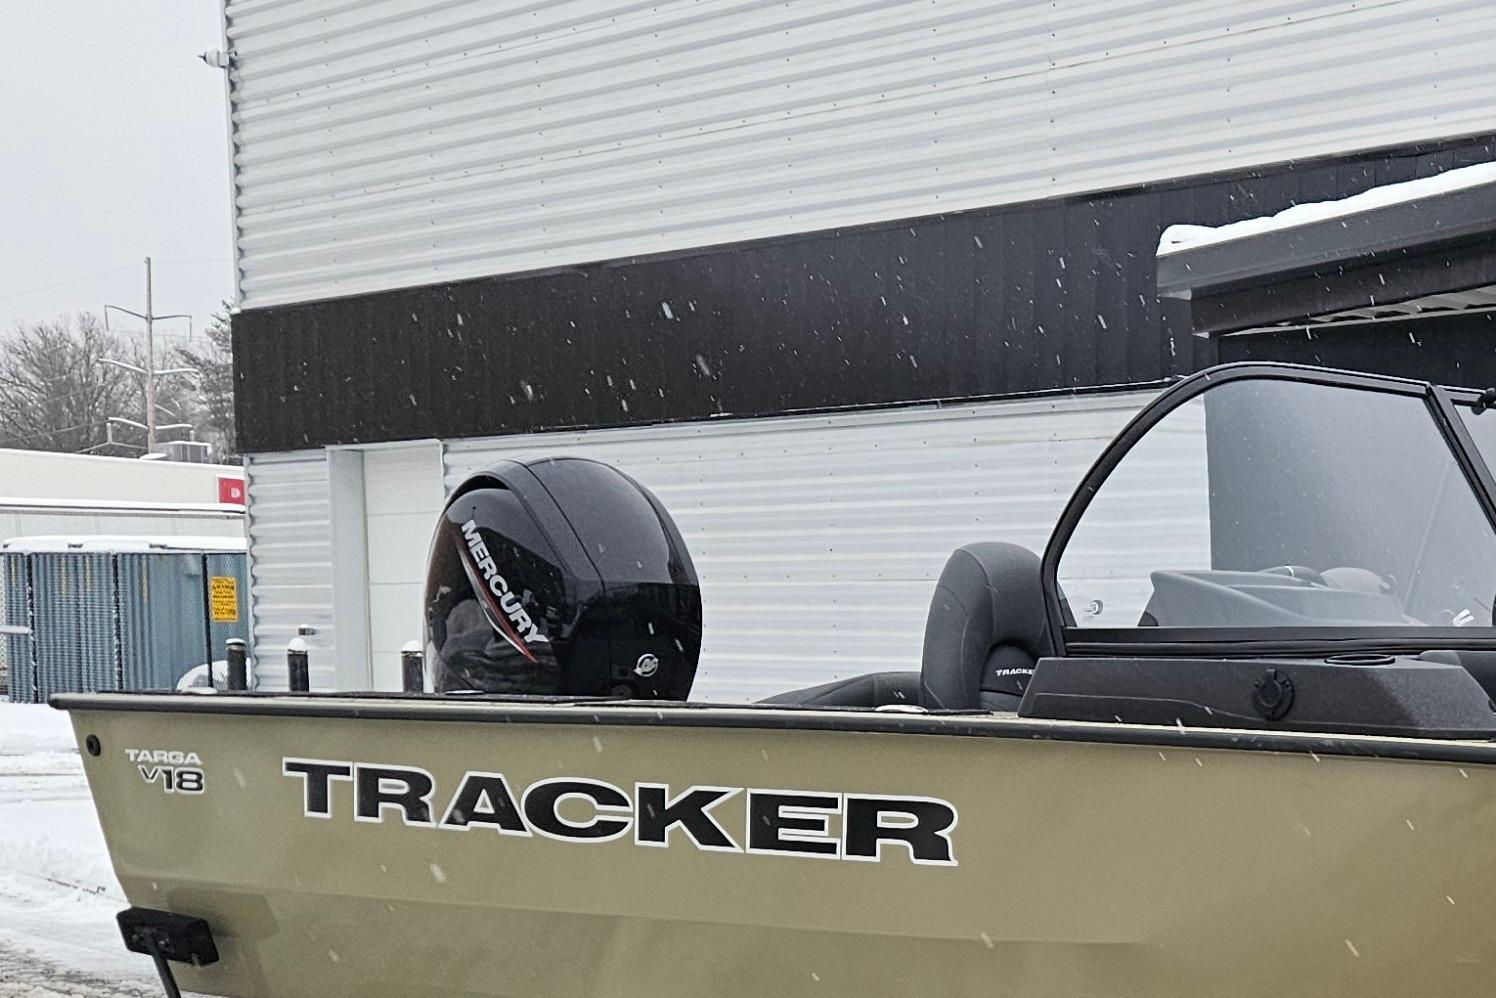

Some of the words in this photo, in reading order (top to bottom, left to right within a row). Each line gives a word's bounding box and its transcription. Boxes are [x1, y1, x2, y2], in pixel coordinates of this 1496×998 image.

[461, 519, 549, 643] MERCURY
[995, 668, 1034, 677] TRACKE
[125, 748, 203, 766] TARGA
[138, 764, 205, 795] V18
[282, 757, 959, 867] TRACKER
